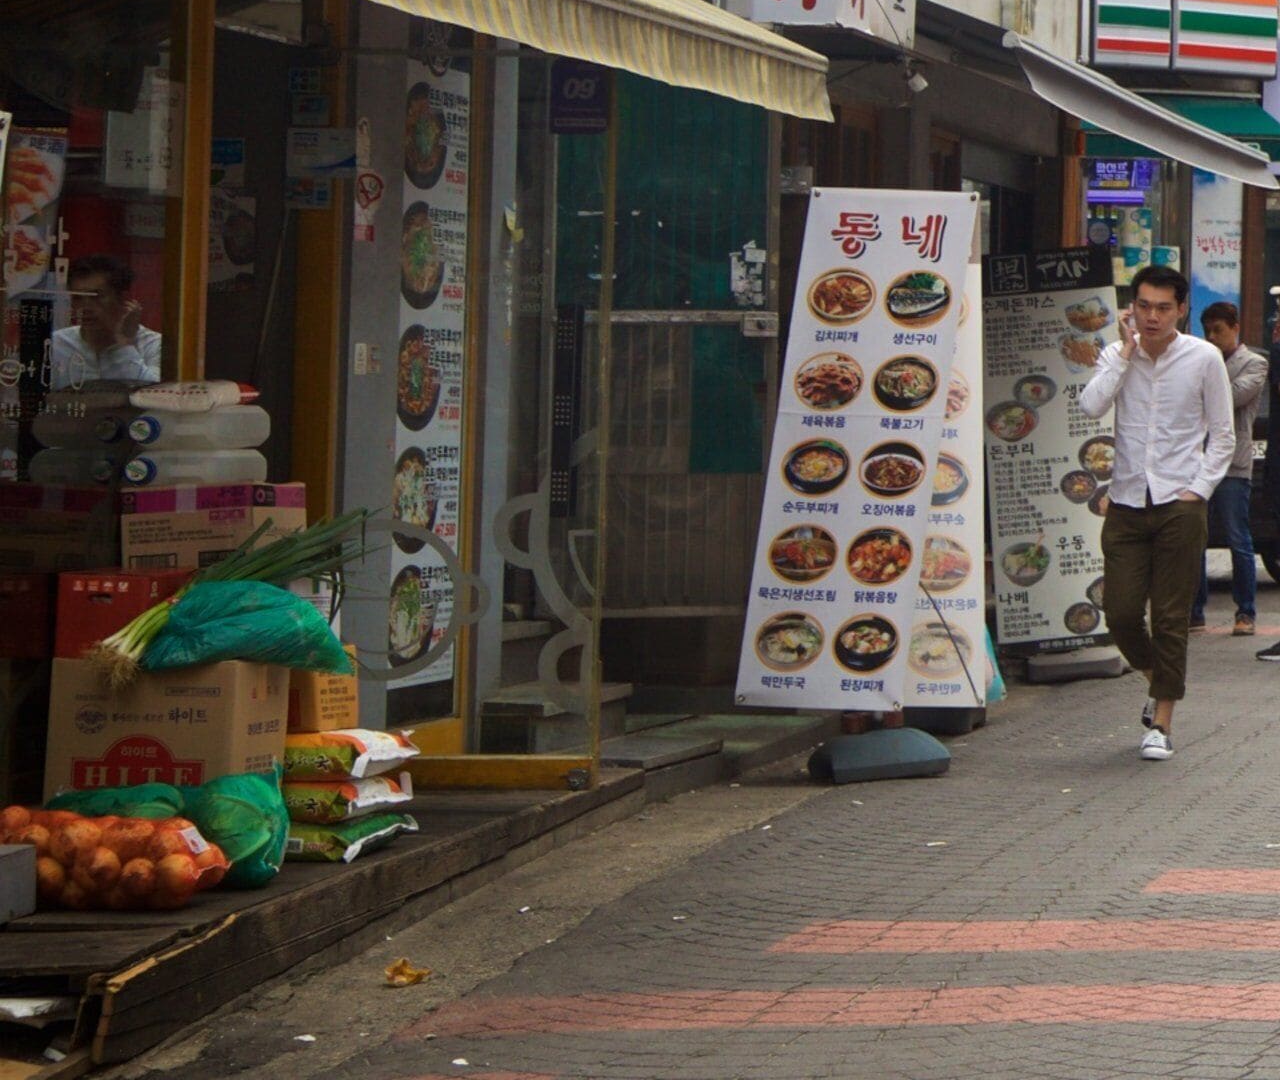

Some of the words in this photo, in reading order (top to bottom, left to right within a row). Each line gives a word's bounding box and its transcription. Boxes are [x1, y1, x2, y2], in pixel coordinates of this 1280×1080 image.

[831, 211, 948, 263] 동네
[814, 330, 859, 343] 김치찌개
[892, 333, 937, 346] 생선구이
[801, 415, 846, 429] 제육볶음
[879, 416, 924, 431] 뚝불고기
[989, 442, 1035, 461] 돈부리
[782, 501, 840, 515] 순두부찌개
[861, 503, 916, 517] 오징어볶음
[1054, 534, 1085, 552] 우동
[757, 586, 837, 603] 묵은지생선조림
[853, 590, 898, 604] 닭볶음탕
[998, 591, 1029, 605] 나베
[760, 675, 807, 690] 떡만두국
[839, 678, 884, 693] 된장찌개
[119, 745, 159, 759] 하이트
[84, 766, 195, 788] HITE
